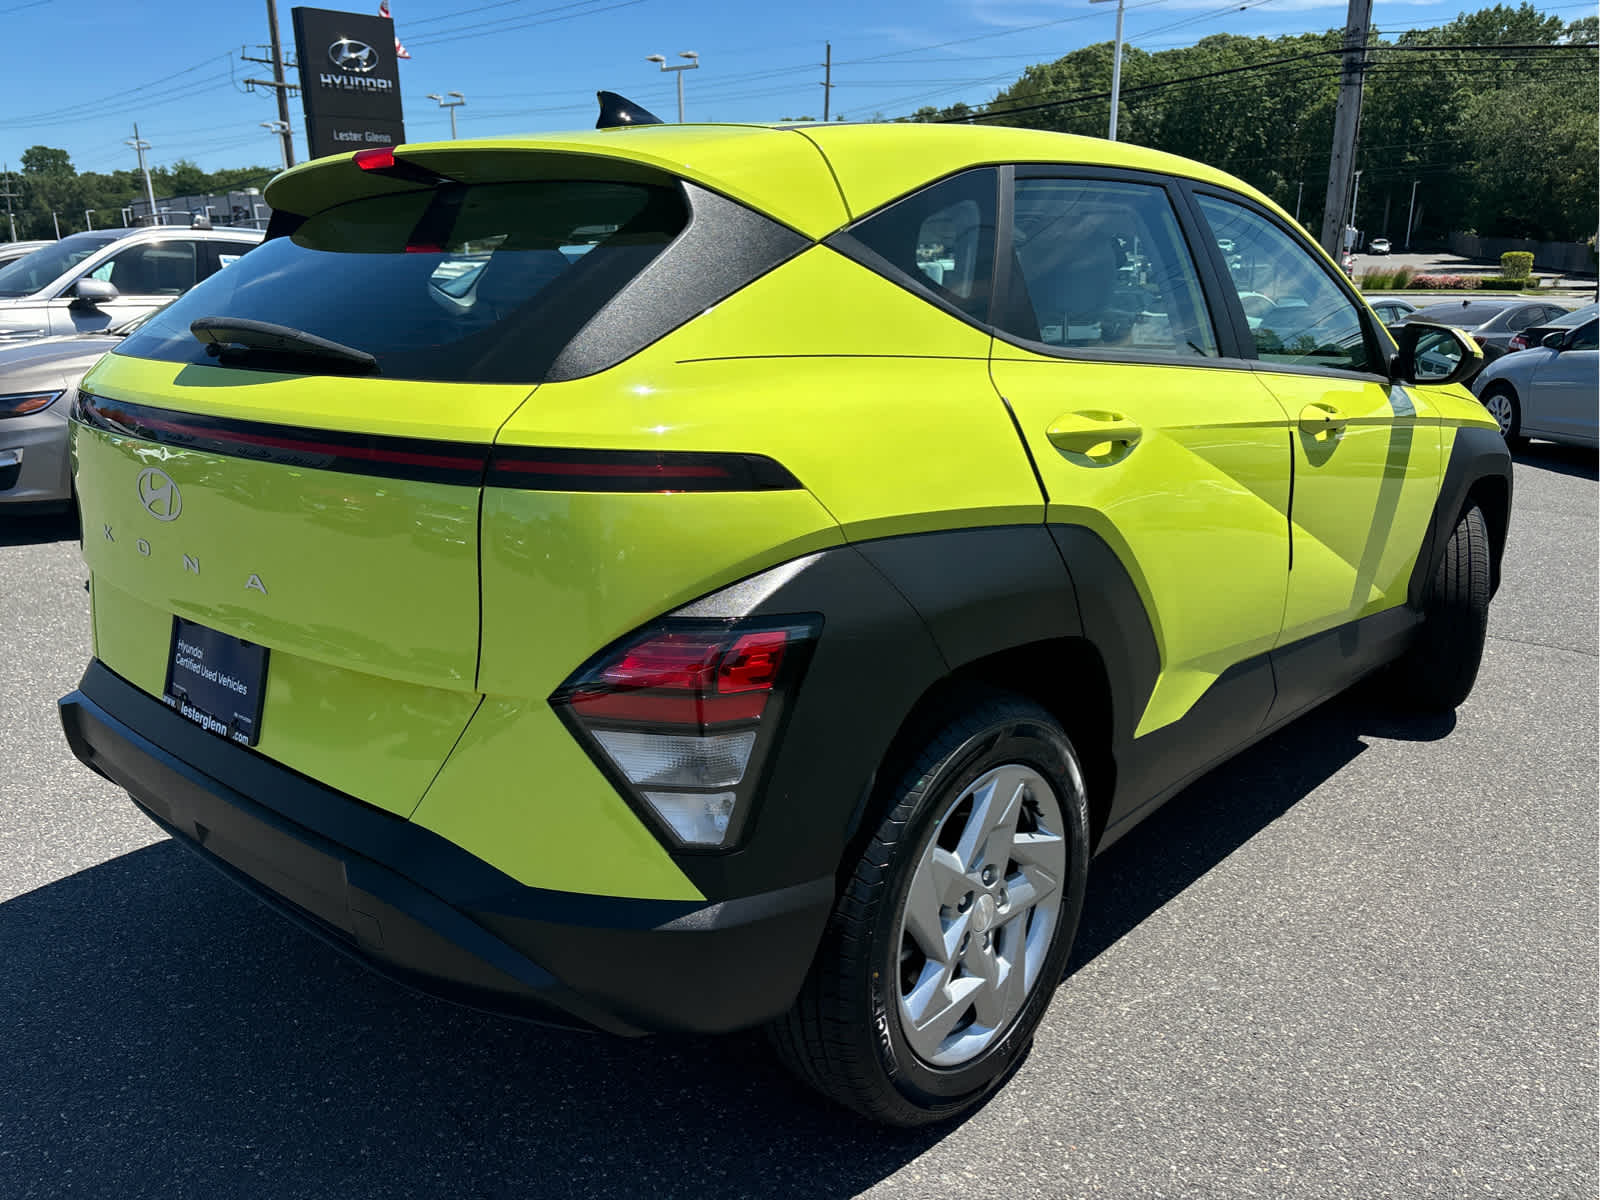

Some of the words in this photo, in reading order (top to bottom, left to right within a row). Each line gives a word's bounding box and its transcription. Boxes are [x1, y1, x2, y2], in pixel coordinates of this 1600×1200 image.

[320, 73, 392, 90] HYUNDAI
[333, 129, 362, 141] Lester
[365, 131, 392, 143] Glenn
[104, 523, 268, 595] KONA
[177, 639, 204, 659] Hyundai
[175, 653, 201, 674] Certified
[201, 666, 217, 682] Used
[218, 672, 248, 696] Vehicles
[180, 701, 228, 737] lesterglenn
